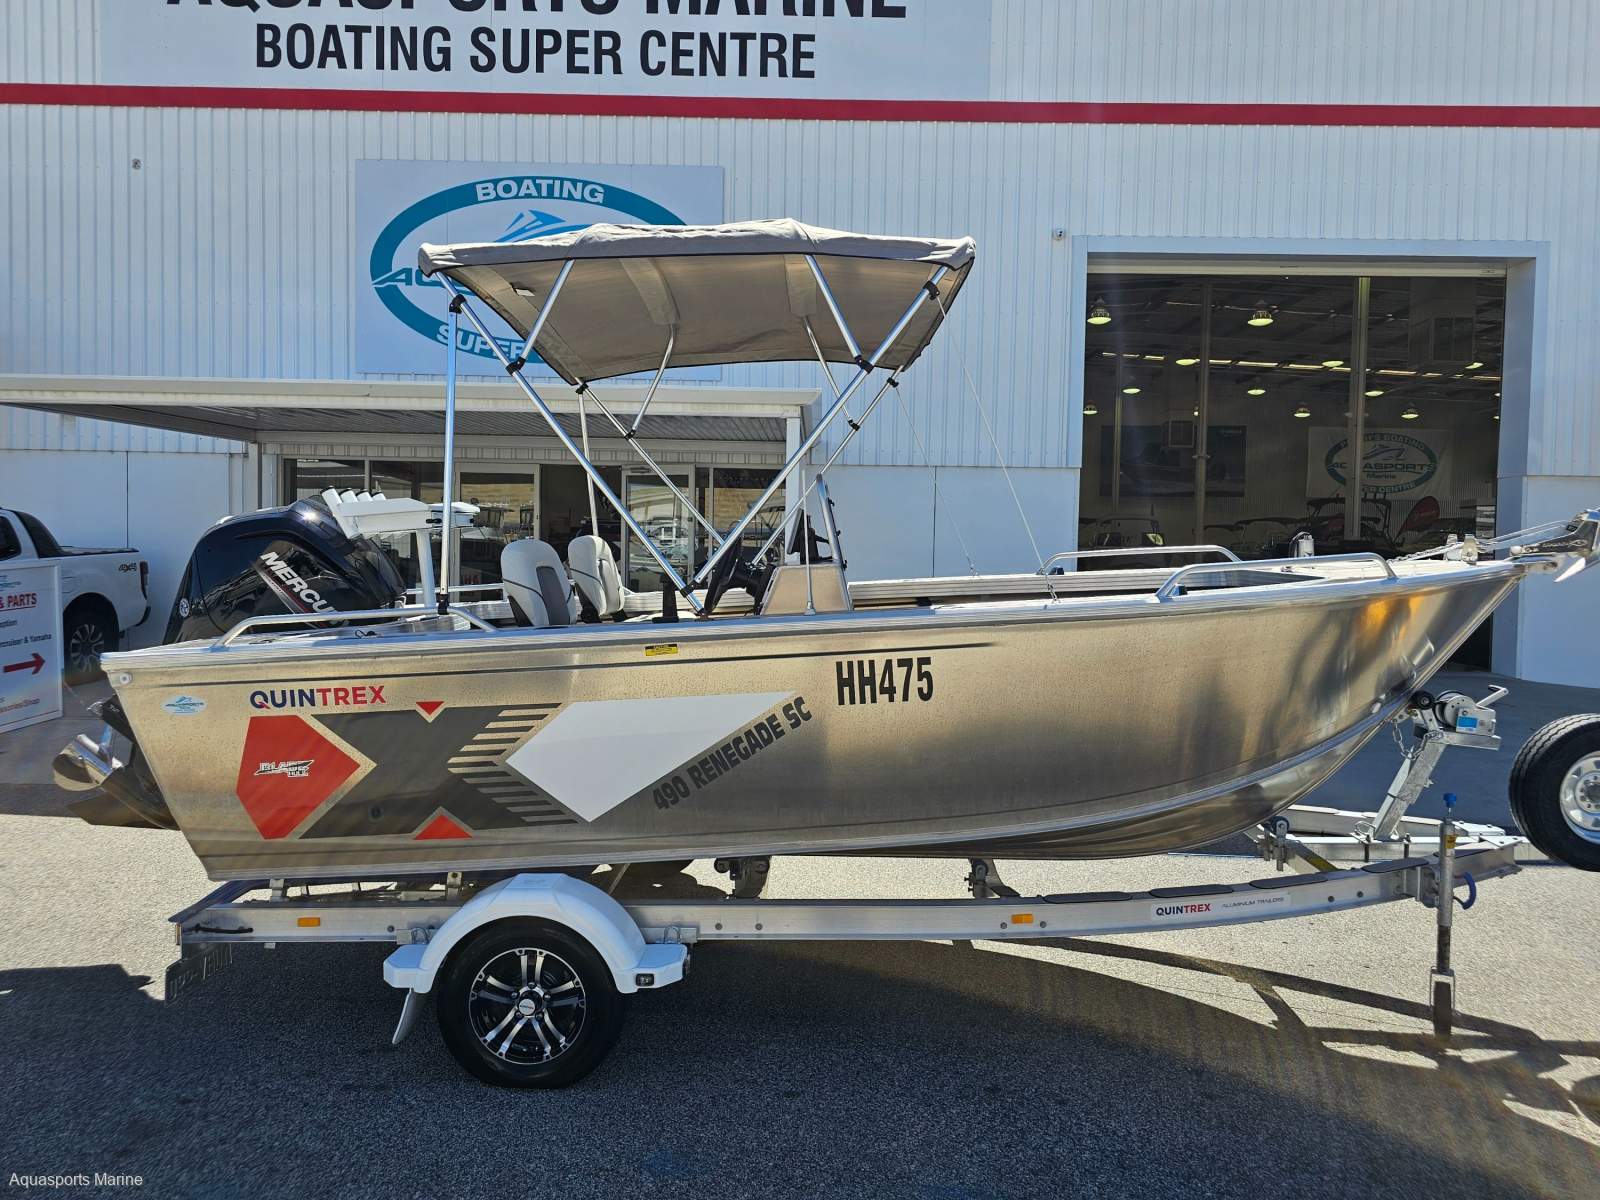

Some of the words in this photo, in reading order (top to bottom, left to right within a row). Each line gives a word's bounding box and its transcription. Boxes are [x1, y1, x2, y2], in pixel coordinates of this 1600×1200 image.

[256, 23, 452, 72] BOATING
[469, 26, 624, 75] SUPER
[639, 31, 816, 78] CENTRE
[475, 178, 606, 204] BOATING
[7, 592, 38, 608] PARTS
[835, 656, 934, 706] HH475
[250, 685, 386, 710] QUINTREX
[653, 775, 691, 810] 490
[689, 713, 786, 789] RENEGADE
[782, 696, 813, 730] SC
[1155, 903, 1212, 917] QUINTREX
